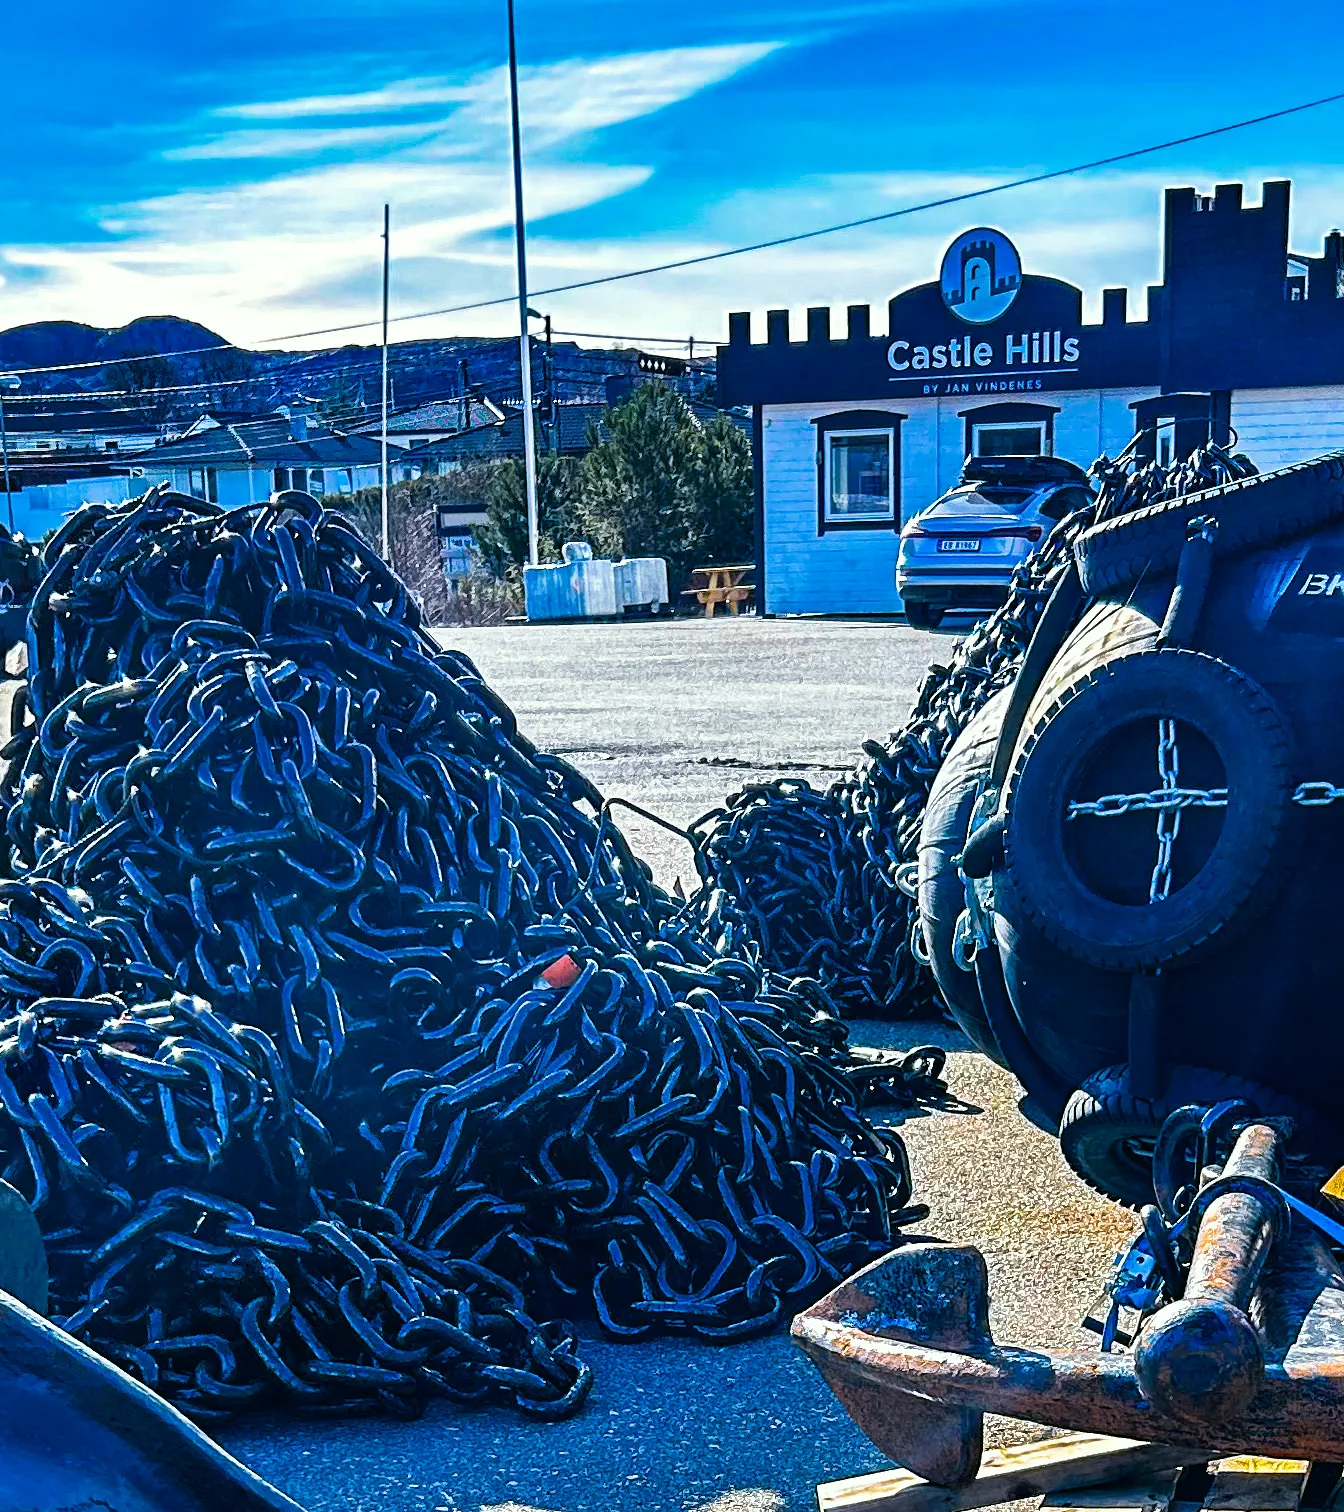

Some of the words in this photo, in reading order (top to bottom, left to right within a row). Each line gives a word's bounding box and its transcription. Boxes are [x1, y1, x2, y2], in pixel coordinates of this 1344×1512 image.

[887, 335, 993, 371] Castle
[1005, 330, 1080, 365] Hills
[923, 384, 938, 395] BY
[945, 382, 969, 394] JAN
[976, 379, 1042, 392] VINDENES
